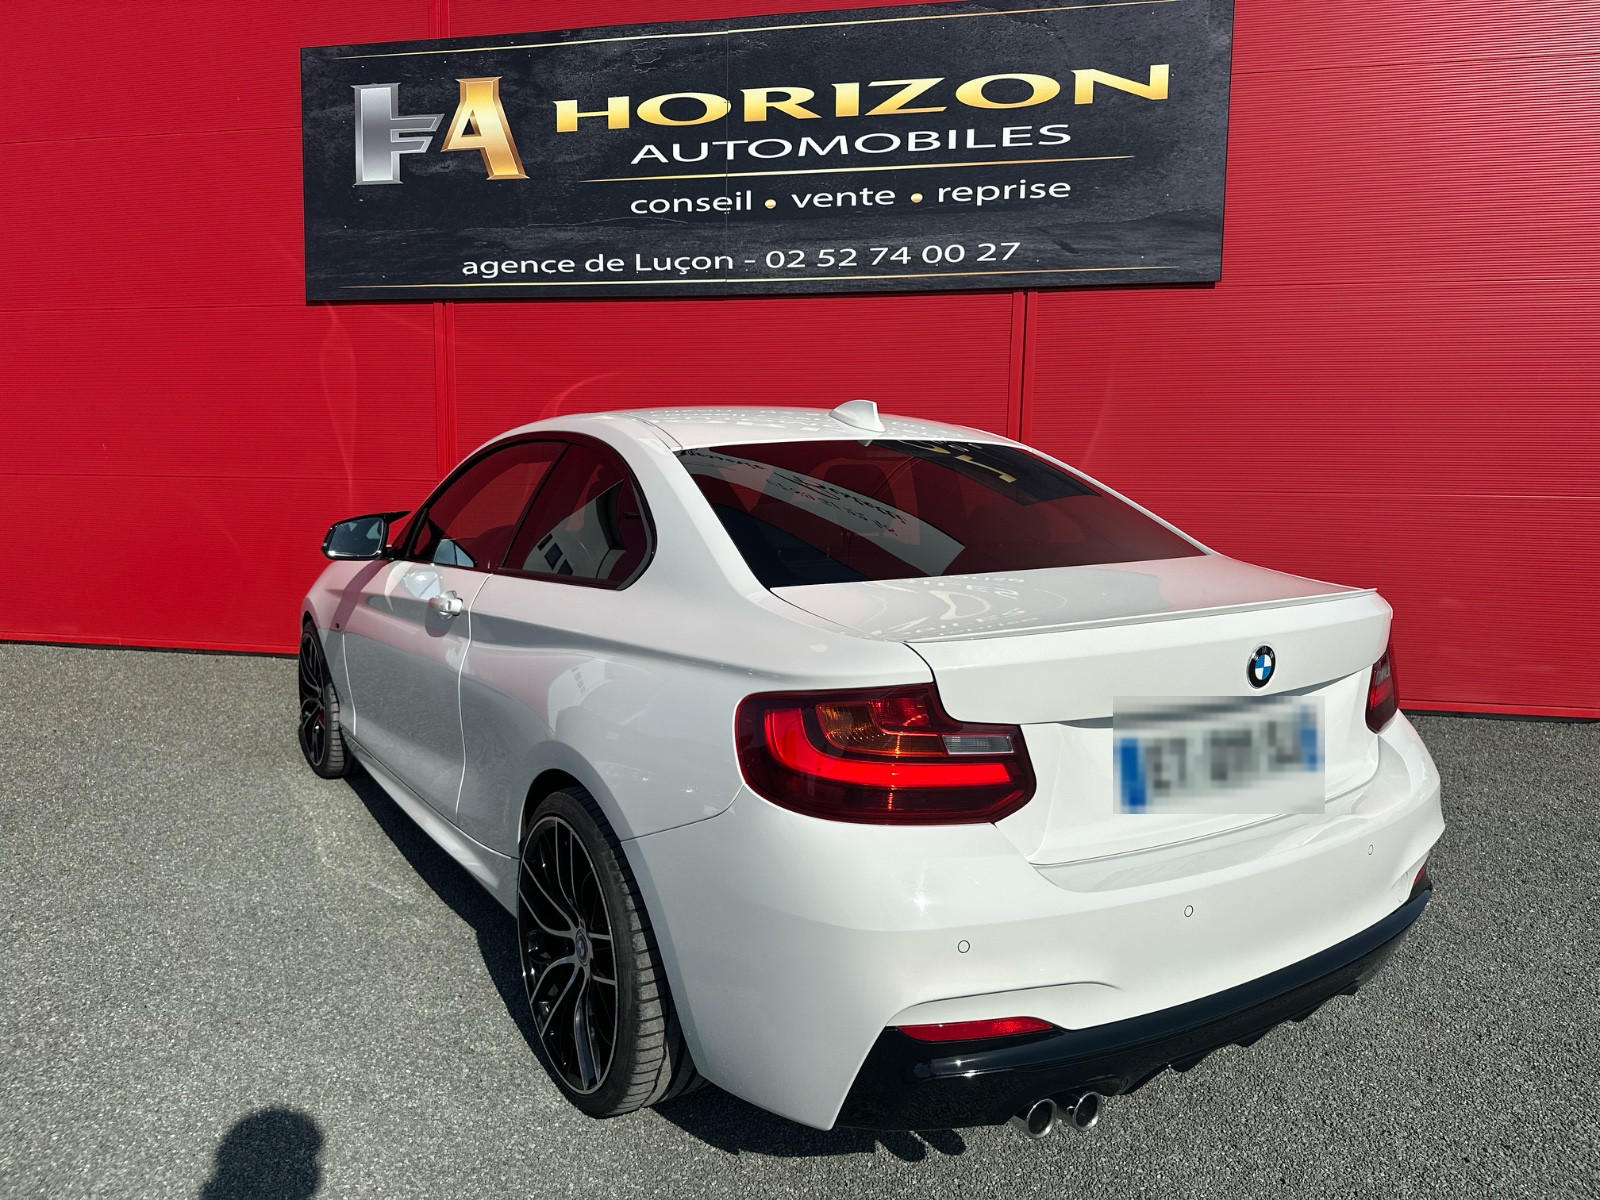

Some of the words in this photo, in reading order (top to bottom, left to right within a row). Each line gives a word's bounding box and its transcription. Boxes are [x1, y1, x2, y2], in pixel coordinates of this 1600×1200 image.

[552, 63, 1170, 133] HORIZON
[630, 124, 1072, 165] AUTOMOBILES
[630, 189, 752, 214] conseil
[791, 187, 896, 209] vente
[938, 179, 1071, 207] reprise
[462, 260, 576, 279] agence
[584, 253, 625, 273] de
[635, 253, 734, 275] Luçon
[765, 249, 806, 269] 02
[816, 248, 858, 268] 52
[869, 246, 912, 266] 74
[921, 243, 966, 264] 00
[976, 241, 1021, 262] 27
